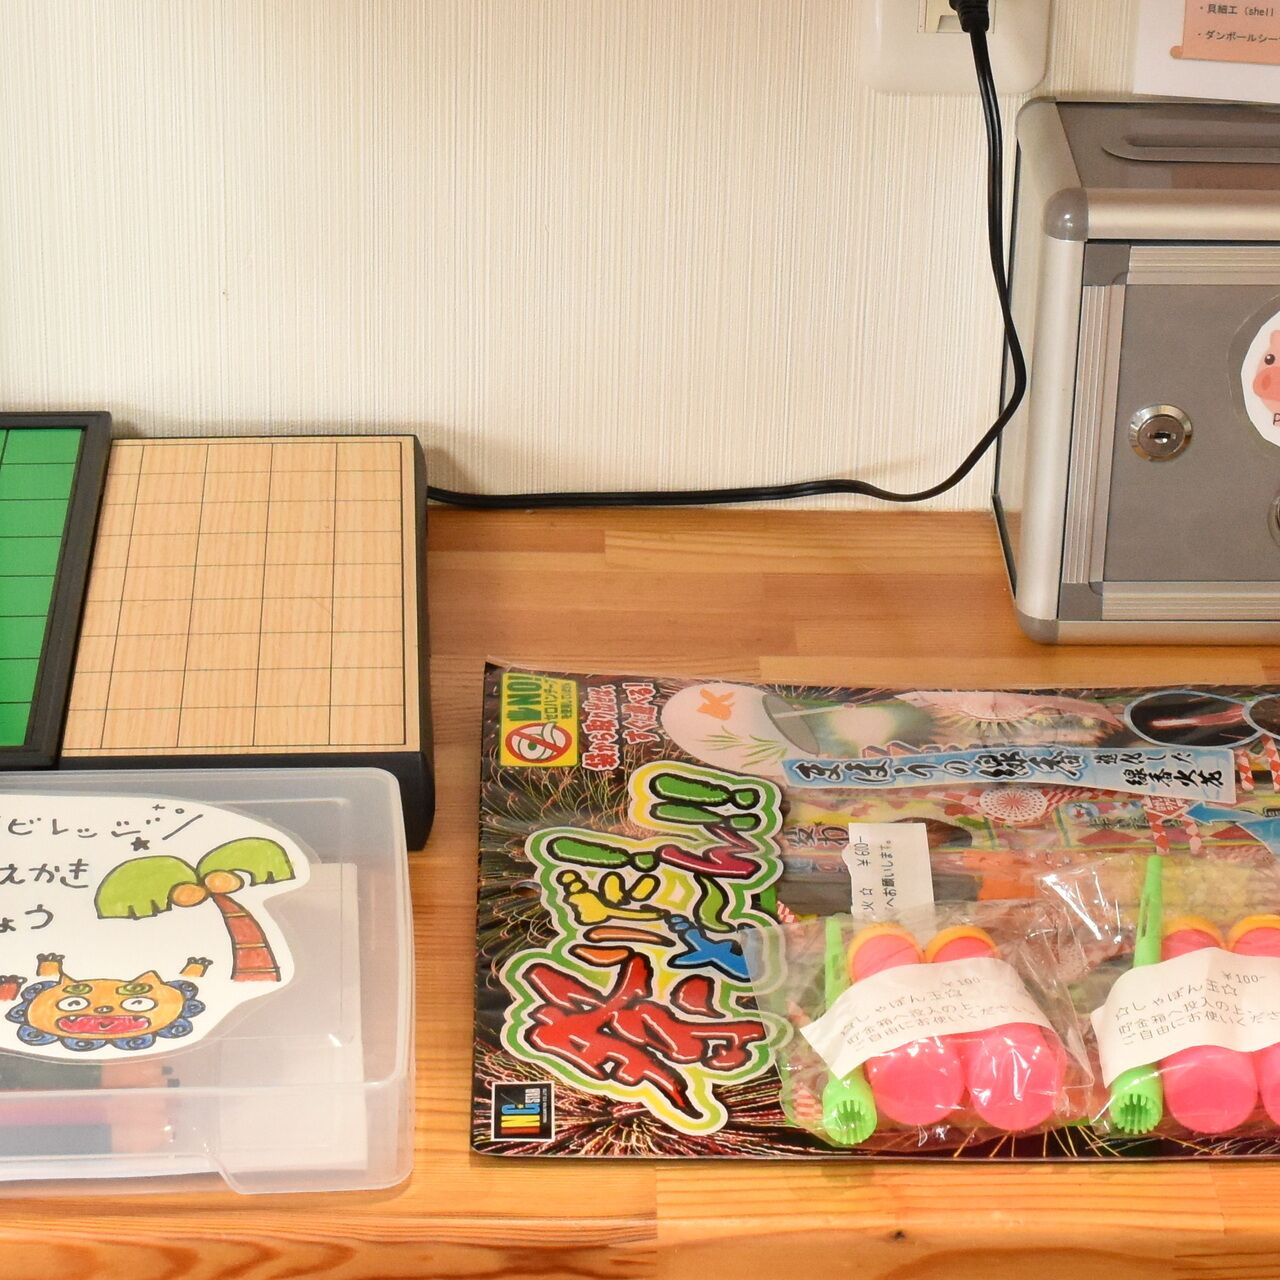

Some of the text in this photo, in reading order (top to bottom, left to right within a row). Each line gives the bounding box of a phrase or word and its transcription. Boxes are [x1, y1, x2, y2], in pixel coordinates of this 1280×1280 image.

[1244, 6, 1275, 18] (shell
[506, 674, 543, 707] NO!
[500, 1103, 541, 1135] ING
